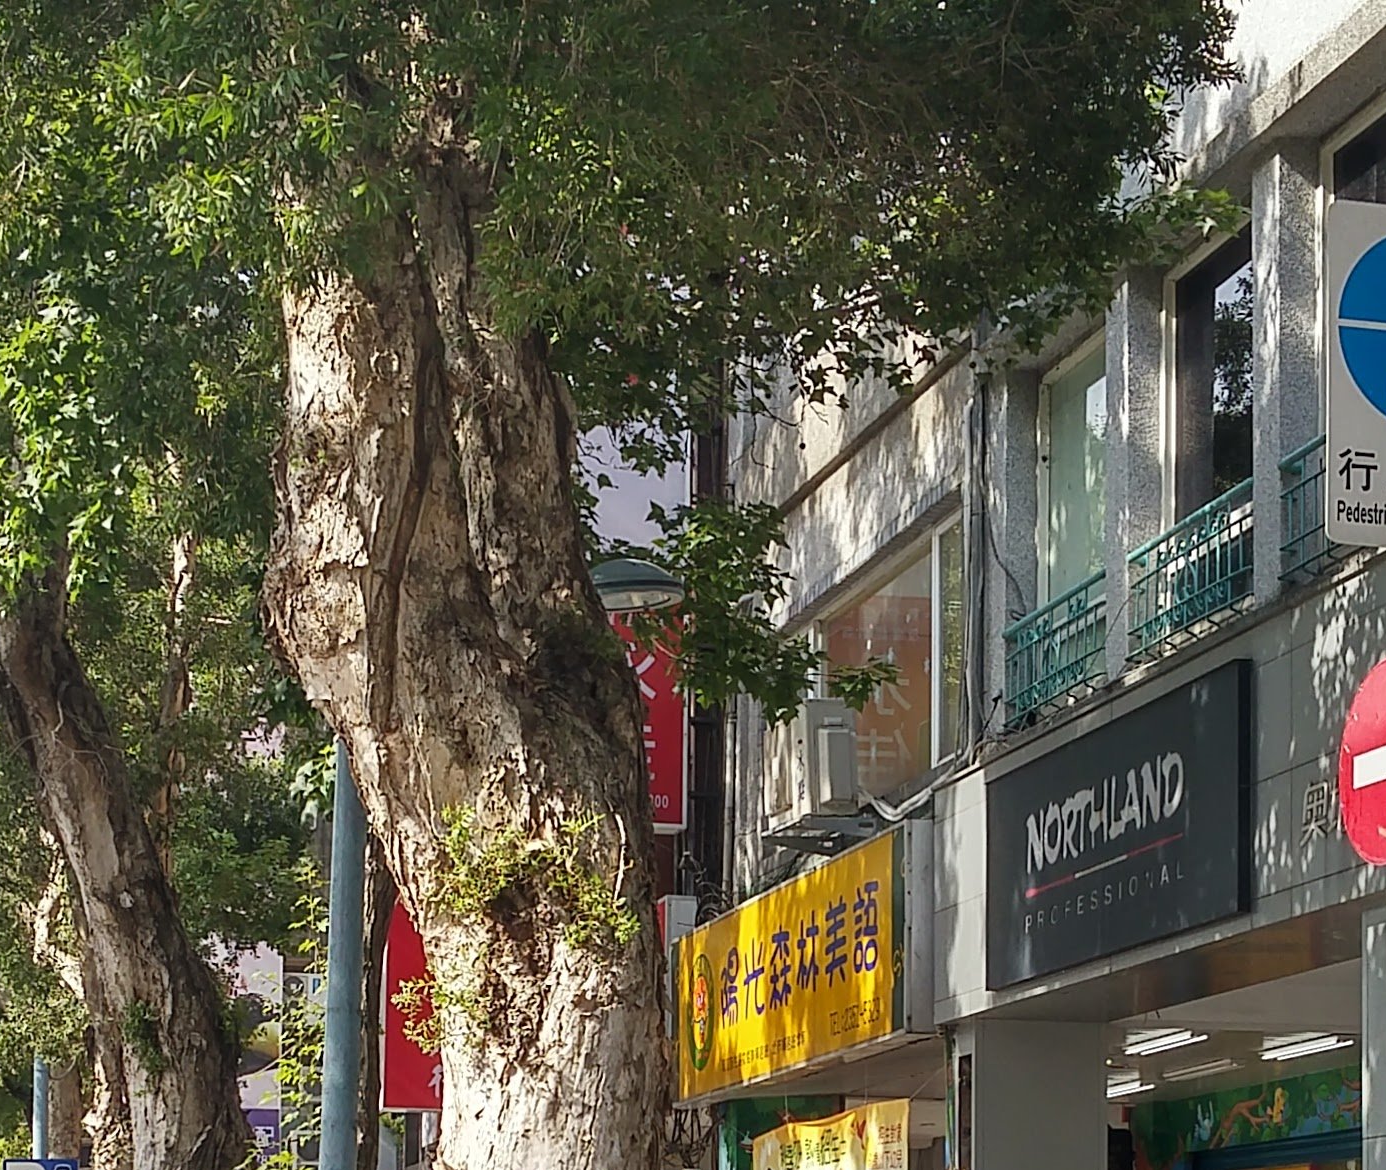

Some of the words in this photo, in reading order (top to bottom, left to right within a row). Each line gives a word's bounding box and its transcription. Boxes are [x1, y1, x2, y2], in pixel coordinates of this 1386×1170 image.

[1025, 751, 1184, 875] NORTHLAND
[719, 880, 879, 1030] 陽光森林美語
[1024, 860, 1184, 934] PROFESSIONAL
